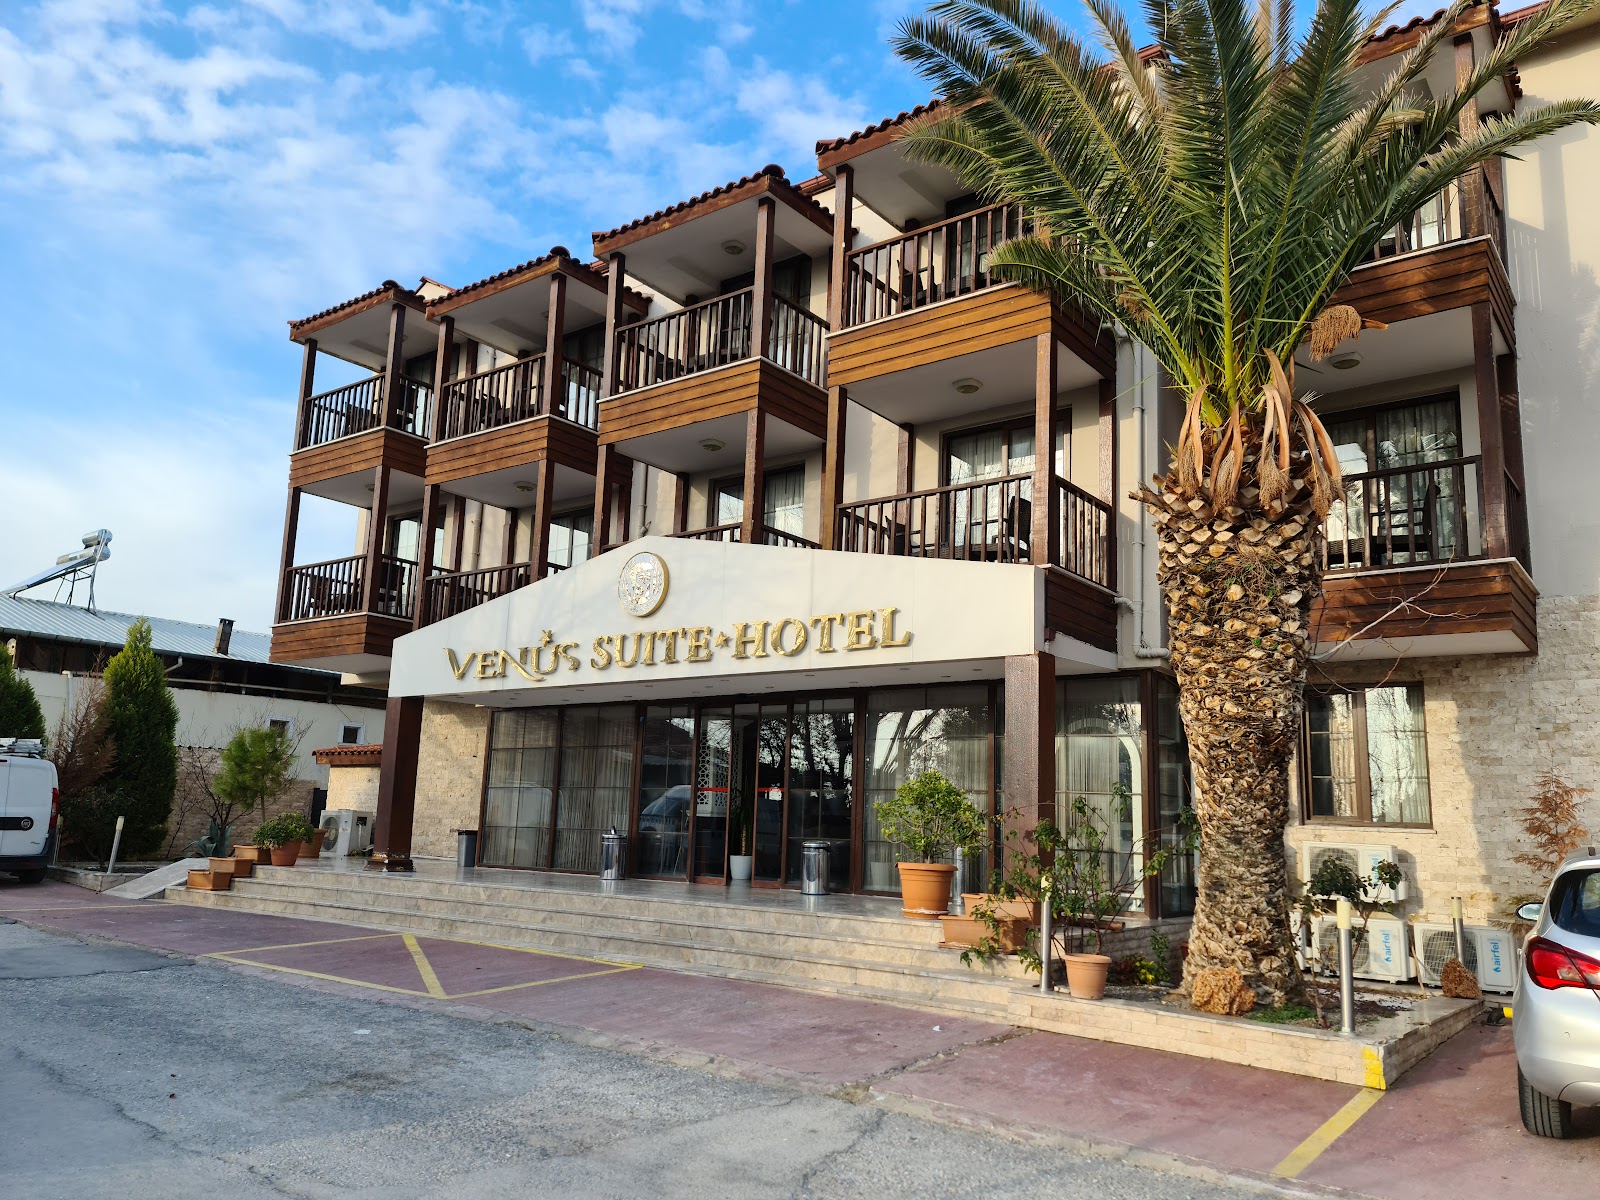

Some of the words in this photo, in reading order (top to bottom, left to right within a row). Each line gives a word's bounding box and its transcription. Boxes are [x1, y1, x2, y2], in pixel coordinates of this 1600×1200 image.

[443, 630, 580, 682] VENUS
[591, 626, 712, 670] SUITE
[731, 607, 912, 659] HOTEL
[1382, 933, 1391, 956] airfel
[1490, 941, 1501, 966] airfel
